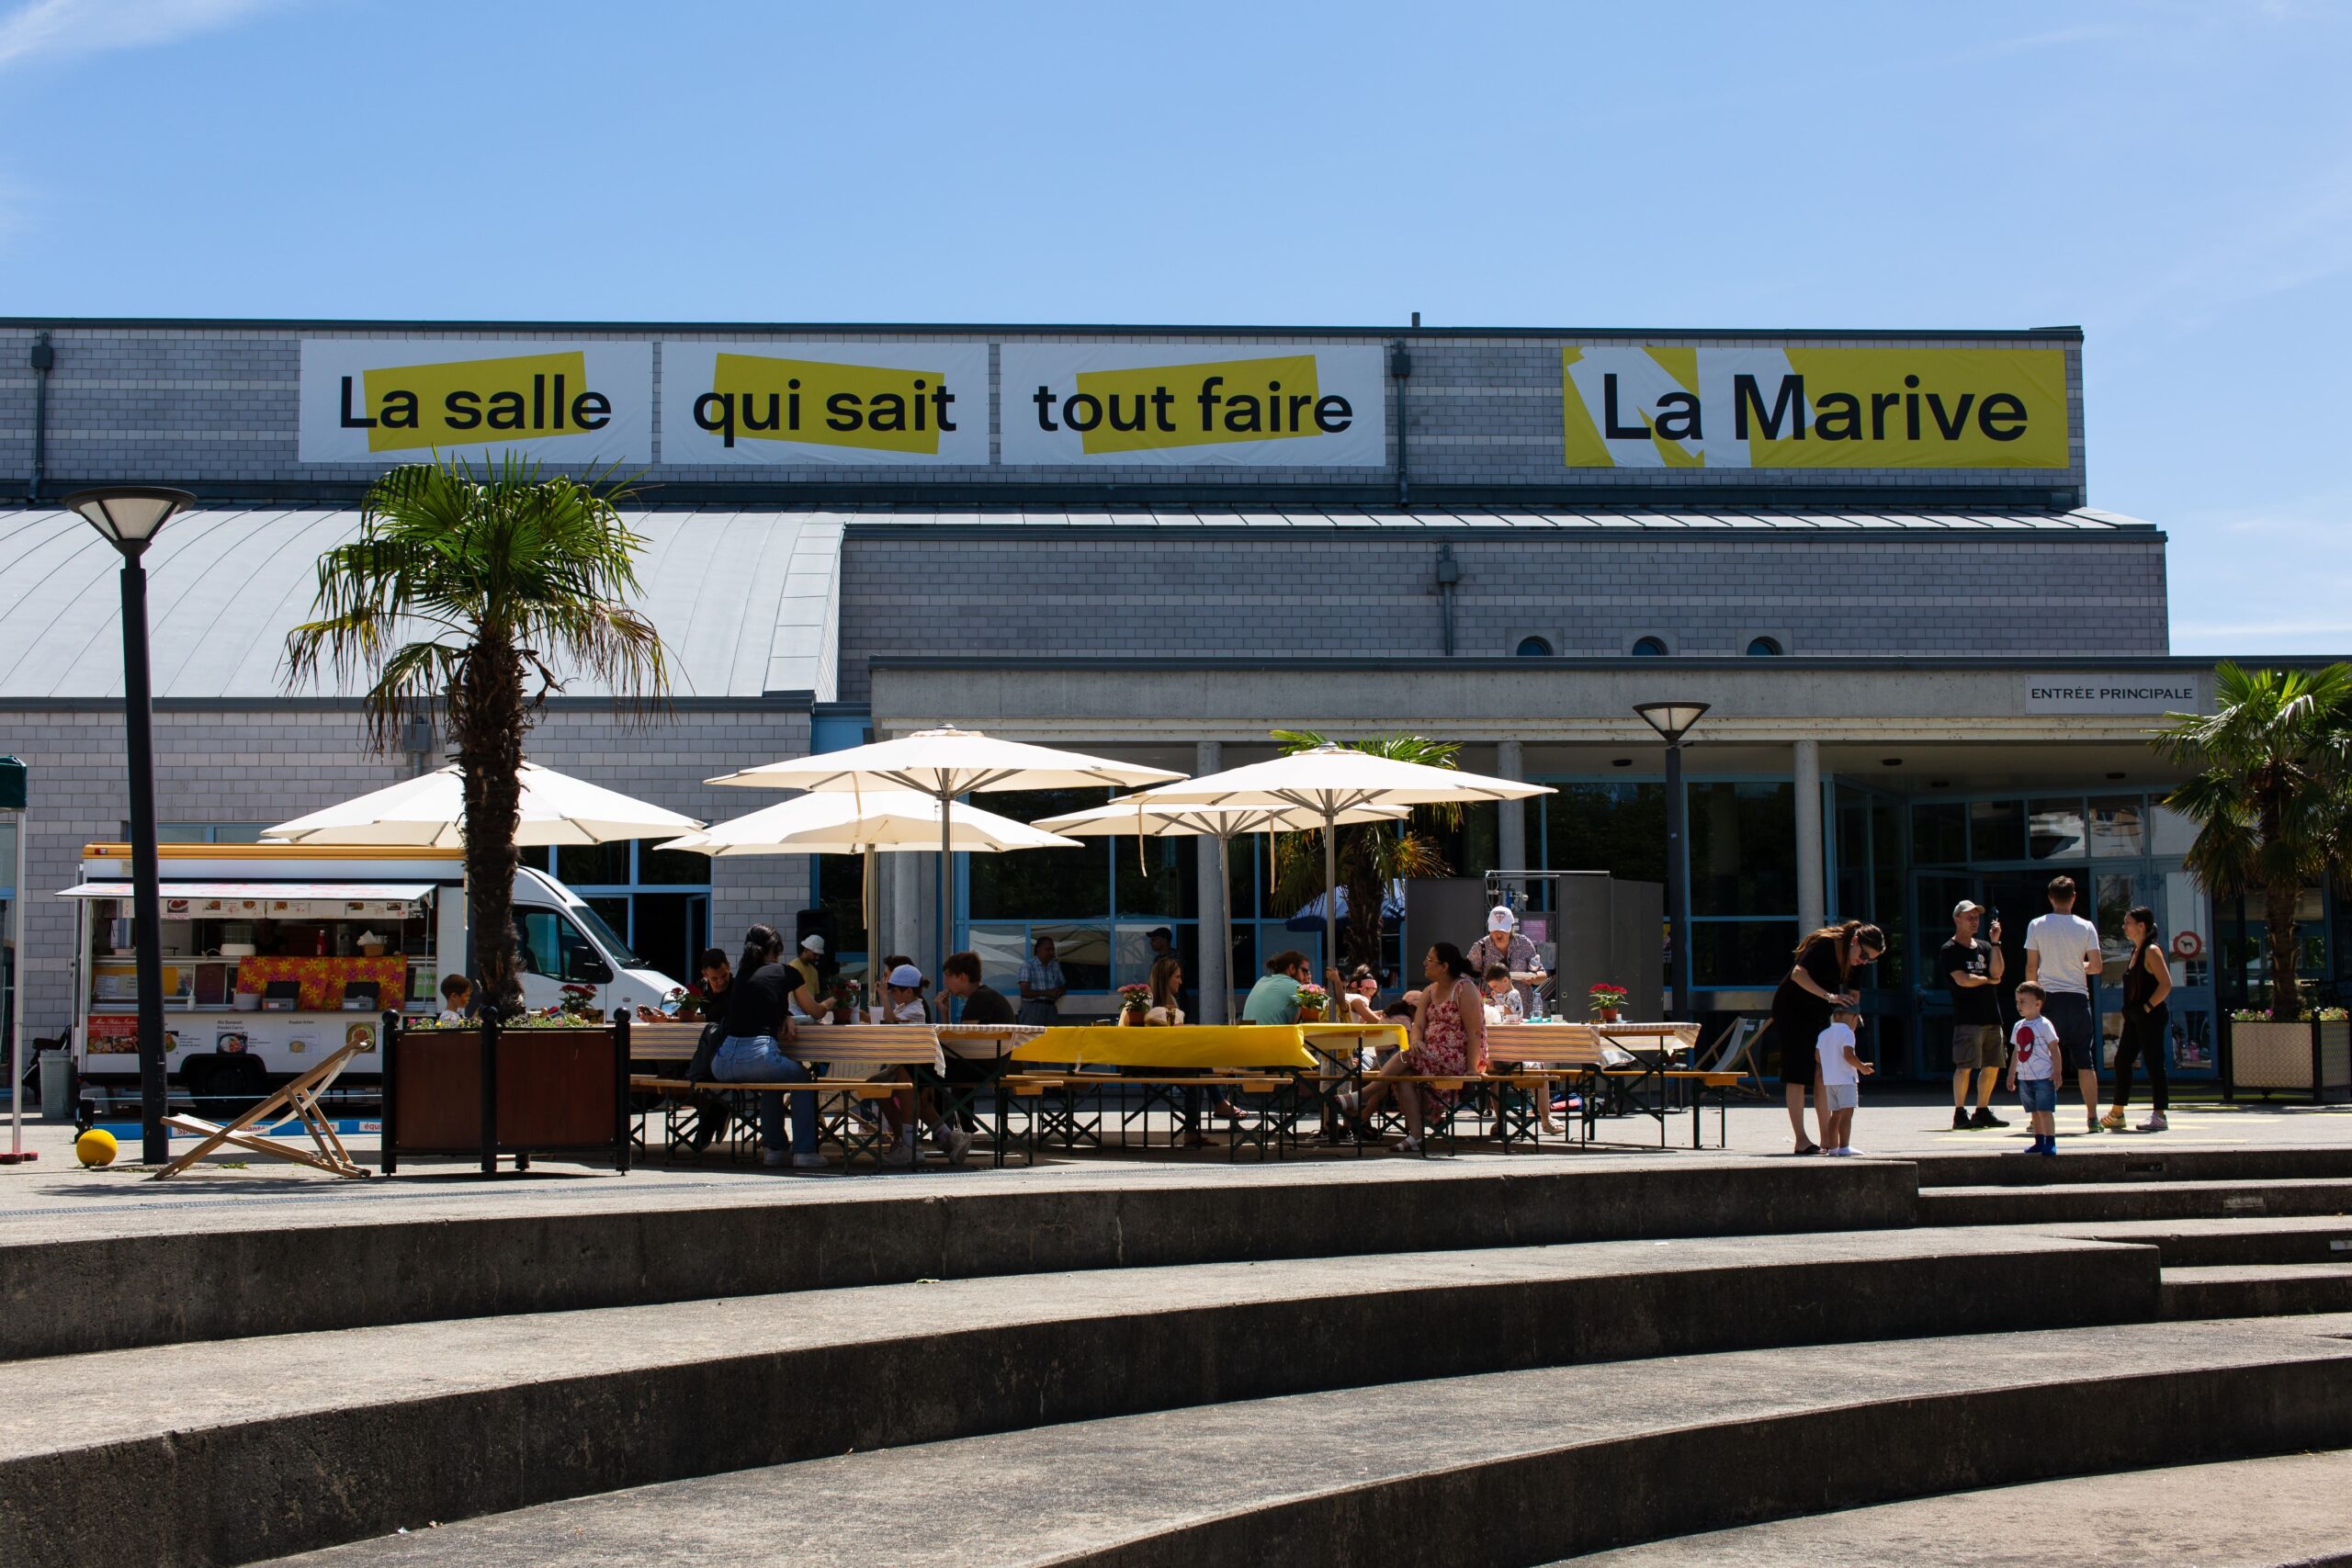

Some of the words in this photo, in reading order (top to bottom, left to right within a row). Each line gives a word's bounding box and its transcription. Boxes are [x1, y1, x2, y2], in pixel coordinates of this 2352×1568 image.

[341, 376, 419, 429] La
[444, 374, 612, 430] salle
[693, 378, 801, 448] qui
[825, 378, 956, 432] sait
[1033, 386, 1176, 432] tout
[1197, 376, 1352, 434] faire
[1603, 373, 1703, 441] La
[1734, 374, 2029, 442] Marive
[2031, 685, 2095, 699] ENTRÉE
[2100, 688, 2193, 699] PRINCIPALE
